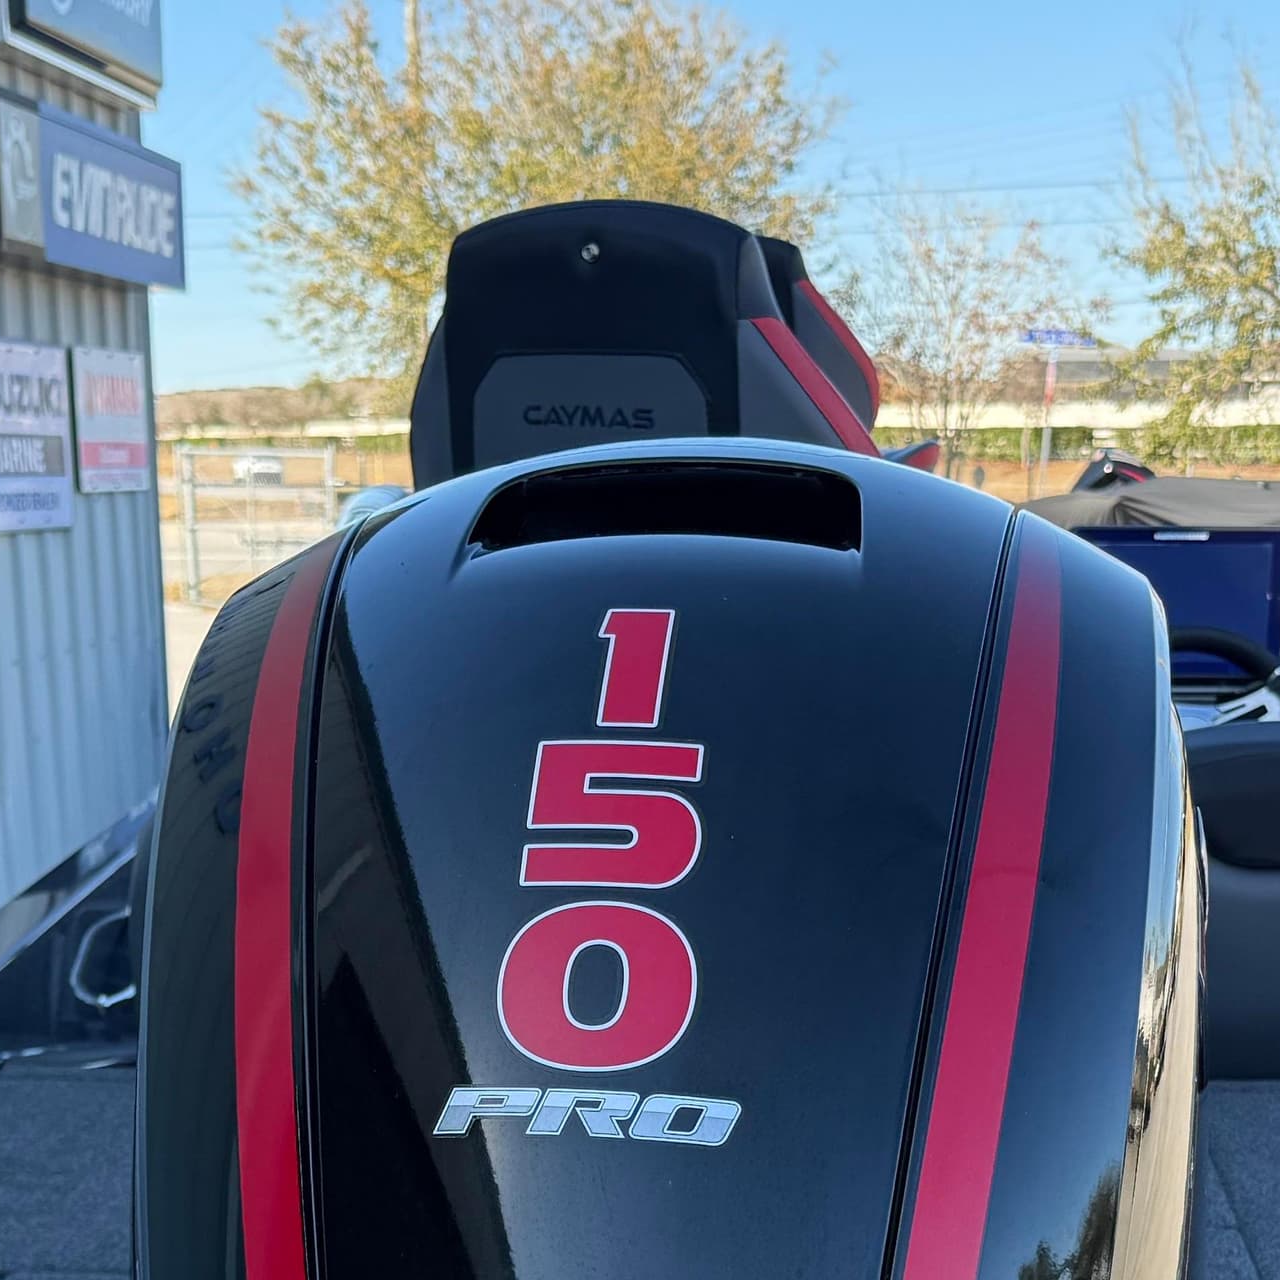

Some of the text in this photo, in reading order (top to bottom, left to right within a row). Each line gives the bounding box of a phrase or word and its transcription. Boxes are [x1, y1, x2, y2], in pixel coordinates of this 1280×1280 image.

[523, 404, 656, 430] CAYMAS
[496, 608, 705, 1073] 150
[432, 1086, 742, 1147] PRO
